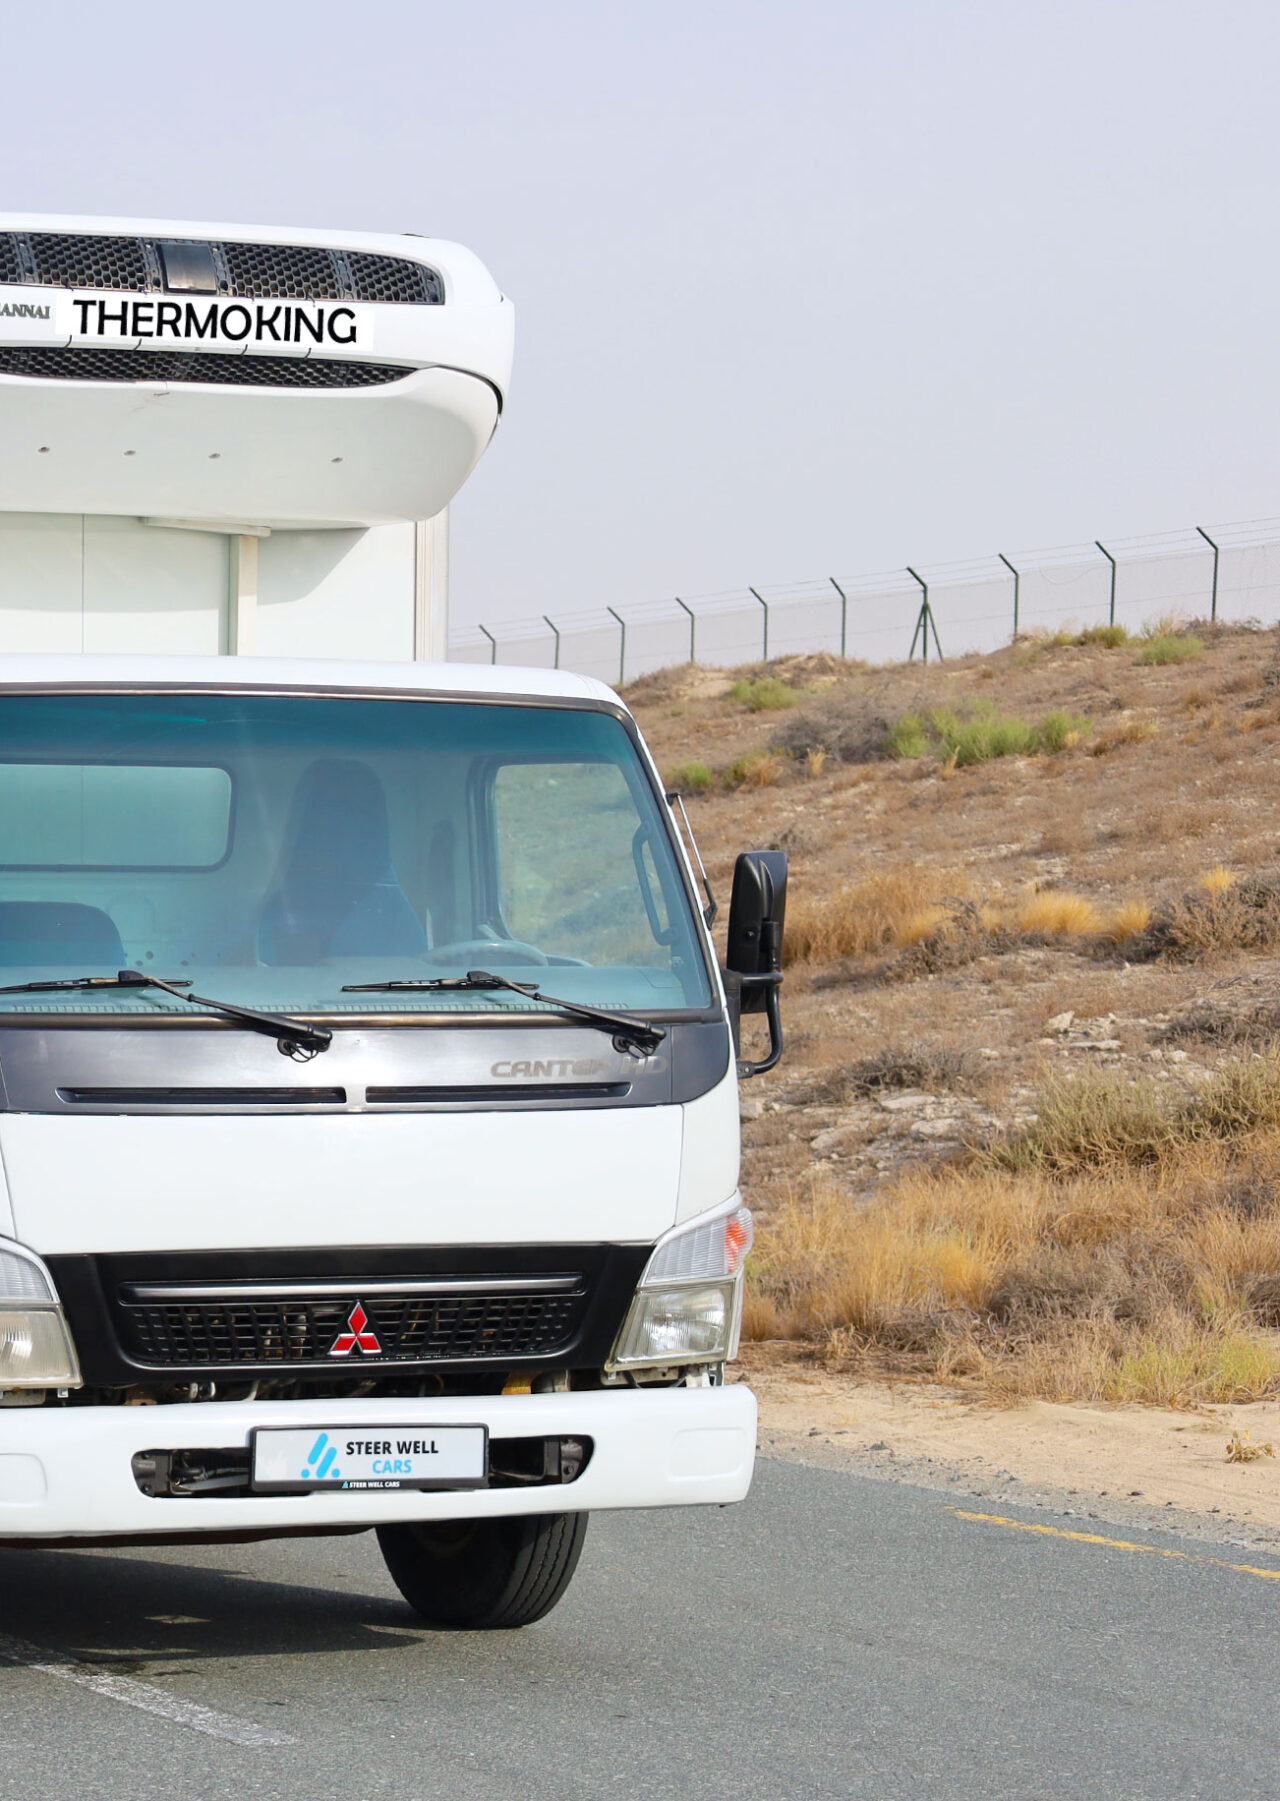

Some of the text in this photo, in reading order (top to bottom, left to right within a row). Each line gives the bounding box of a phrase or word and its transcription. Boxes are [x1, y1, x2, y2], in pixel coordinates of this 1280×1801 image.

[72, 299, 358, 344] THERMOKING
[346, 1440, 439, 1455] STEER WELL
[372, 1459, 412, 1474] CARS
